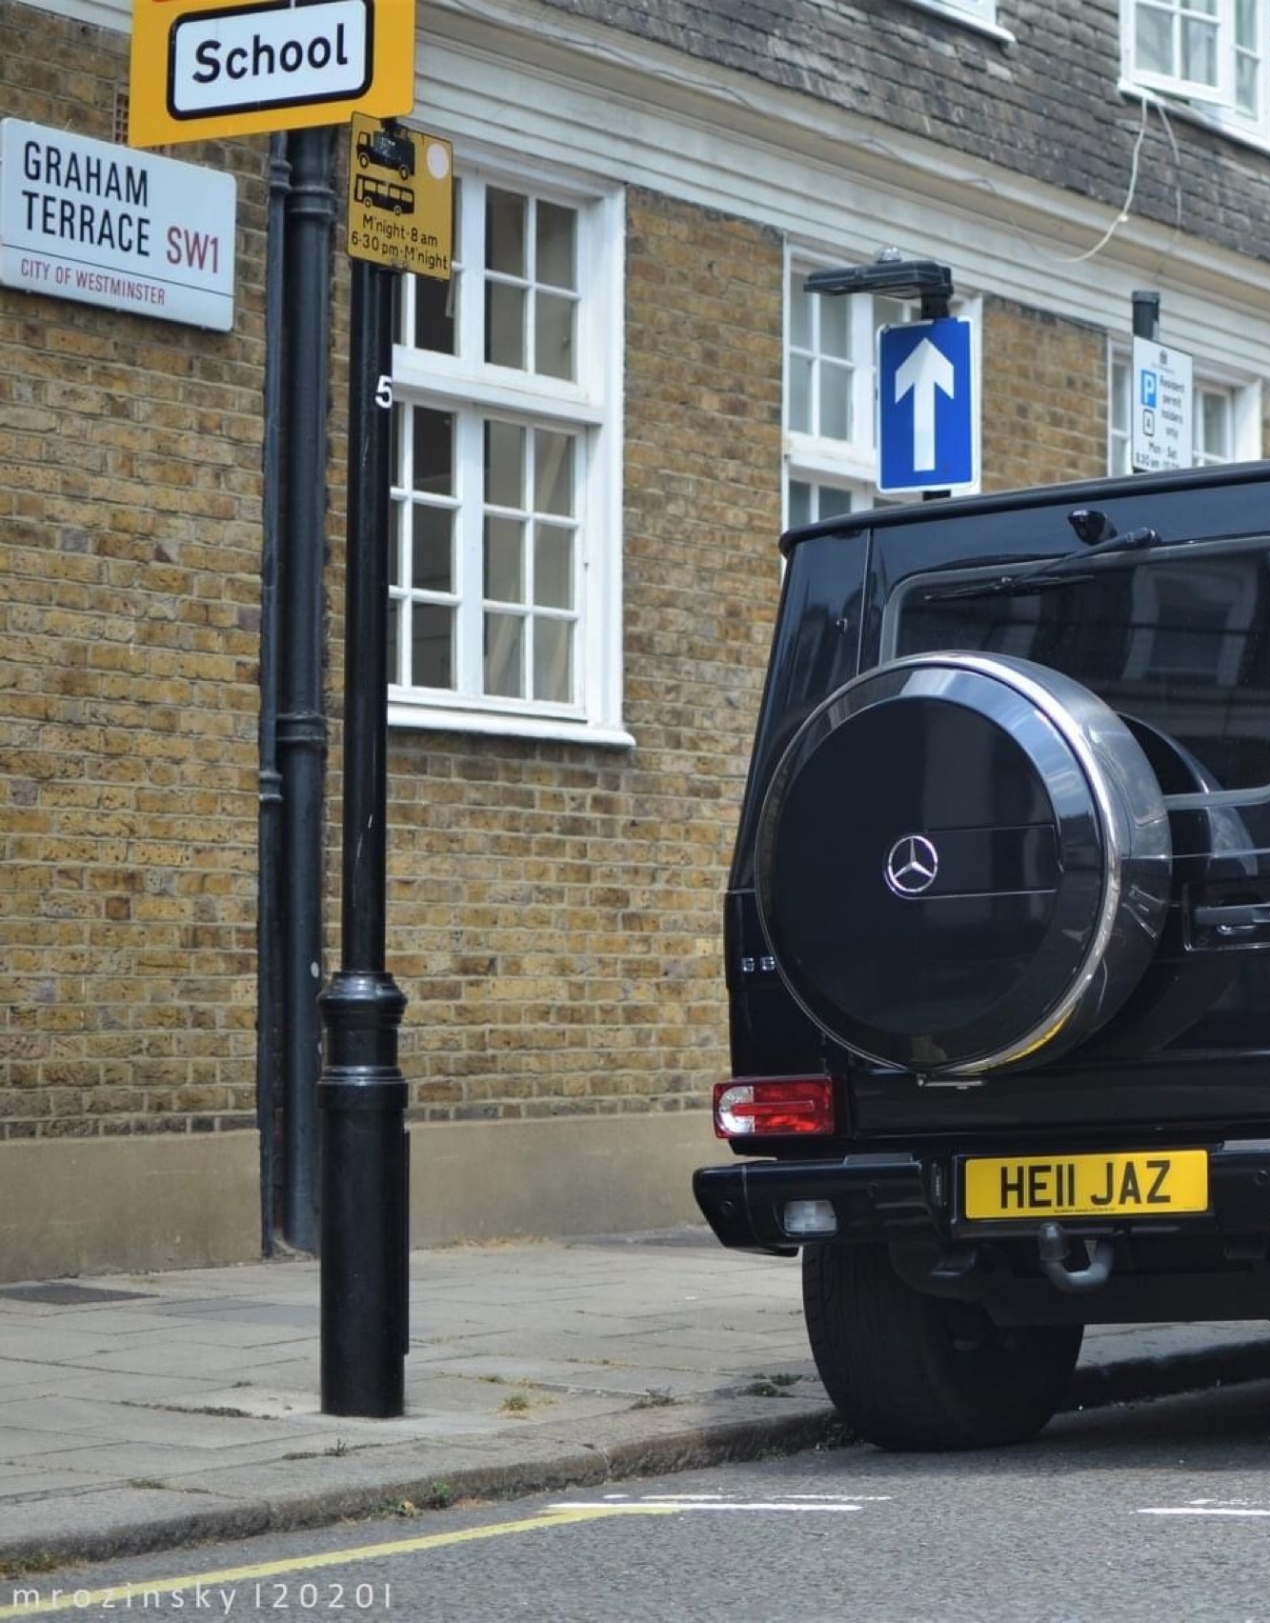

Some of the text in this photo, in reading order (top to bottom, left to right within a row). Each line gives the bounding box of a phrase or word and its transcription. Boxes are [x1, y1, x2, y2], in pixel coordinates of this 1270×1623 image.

[192, 23, 348, 83] School
[24, 140, 149, 207] GRAHAM
[22, 190, 219, 273] TERRACE SW1
[21, 258, 166, 306] CITY OF WESTMINSTER
[375, 375, 393, 408] 5
[1090, 1160, 1171, 1206] JAZ
